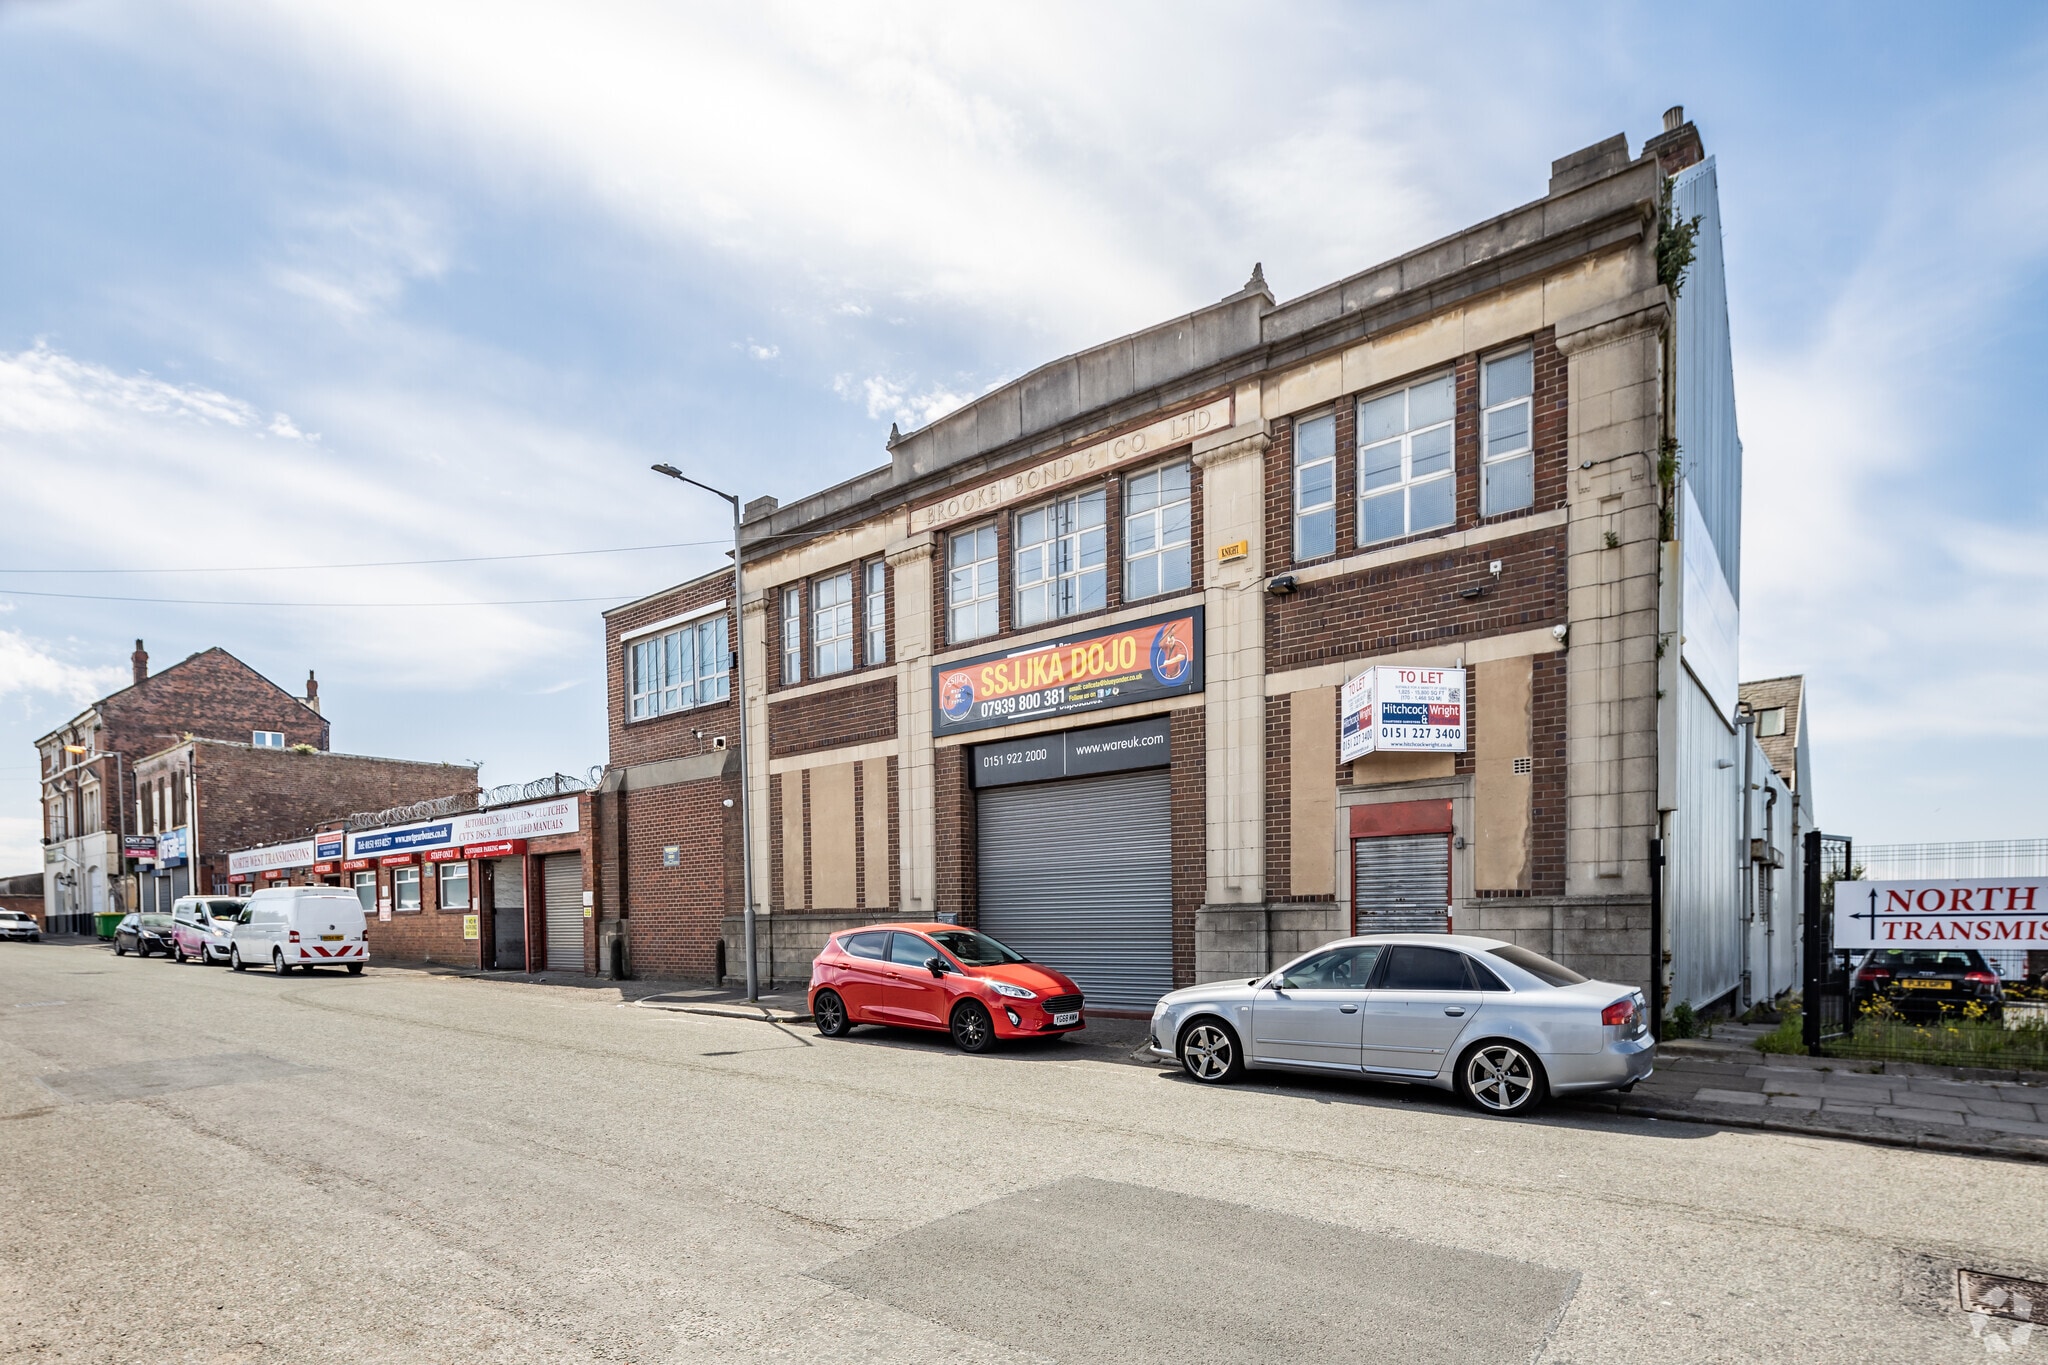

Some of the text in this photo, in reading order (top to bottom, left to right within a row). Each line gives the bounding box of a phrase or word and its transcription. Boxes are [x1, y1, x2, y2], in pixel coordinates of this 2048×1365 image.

[927, 484, 998, 525] BROOKE
[1015, 457, 1074, 495] BOND
[1221, 544, 1239, 558] KNIGHT
[981, 635, 1137, 697] SSJJKA DOJO
[1398, 670, 1444, 684] TO LET
[981, 697, 1017, 718] 07939
[1018, 695, 1041, 711] 800
[1044, 687, 1065, 706] 381
[1068, 693, 1084, 702] Follow
[1383, 703, 1459, 717] Hitchcock Wright
[1421, 715, 1428, 724] &
[1382, 727, 1461, 739] 0151 227 3400
[1076, 733, 1164, 756] www.wareuk.com
[983, 748, 1047, 768] 0151 922 2000
[464, 816, 499, 829] AUTOMATICS
[535, 804, 569, 818] CLUTCHES
[532, 819, 563, 832] MANUALS
[232, 857, 250, 869] NORTH
[250, 855, 264, 866] WEST
[265, 847, 310, 865] TRANSMISSIONS
[1884, 887, 2039, 912] NORTH
